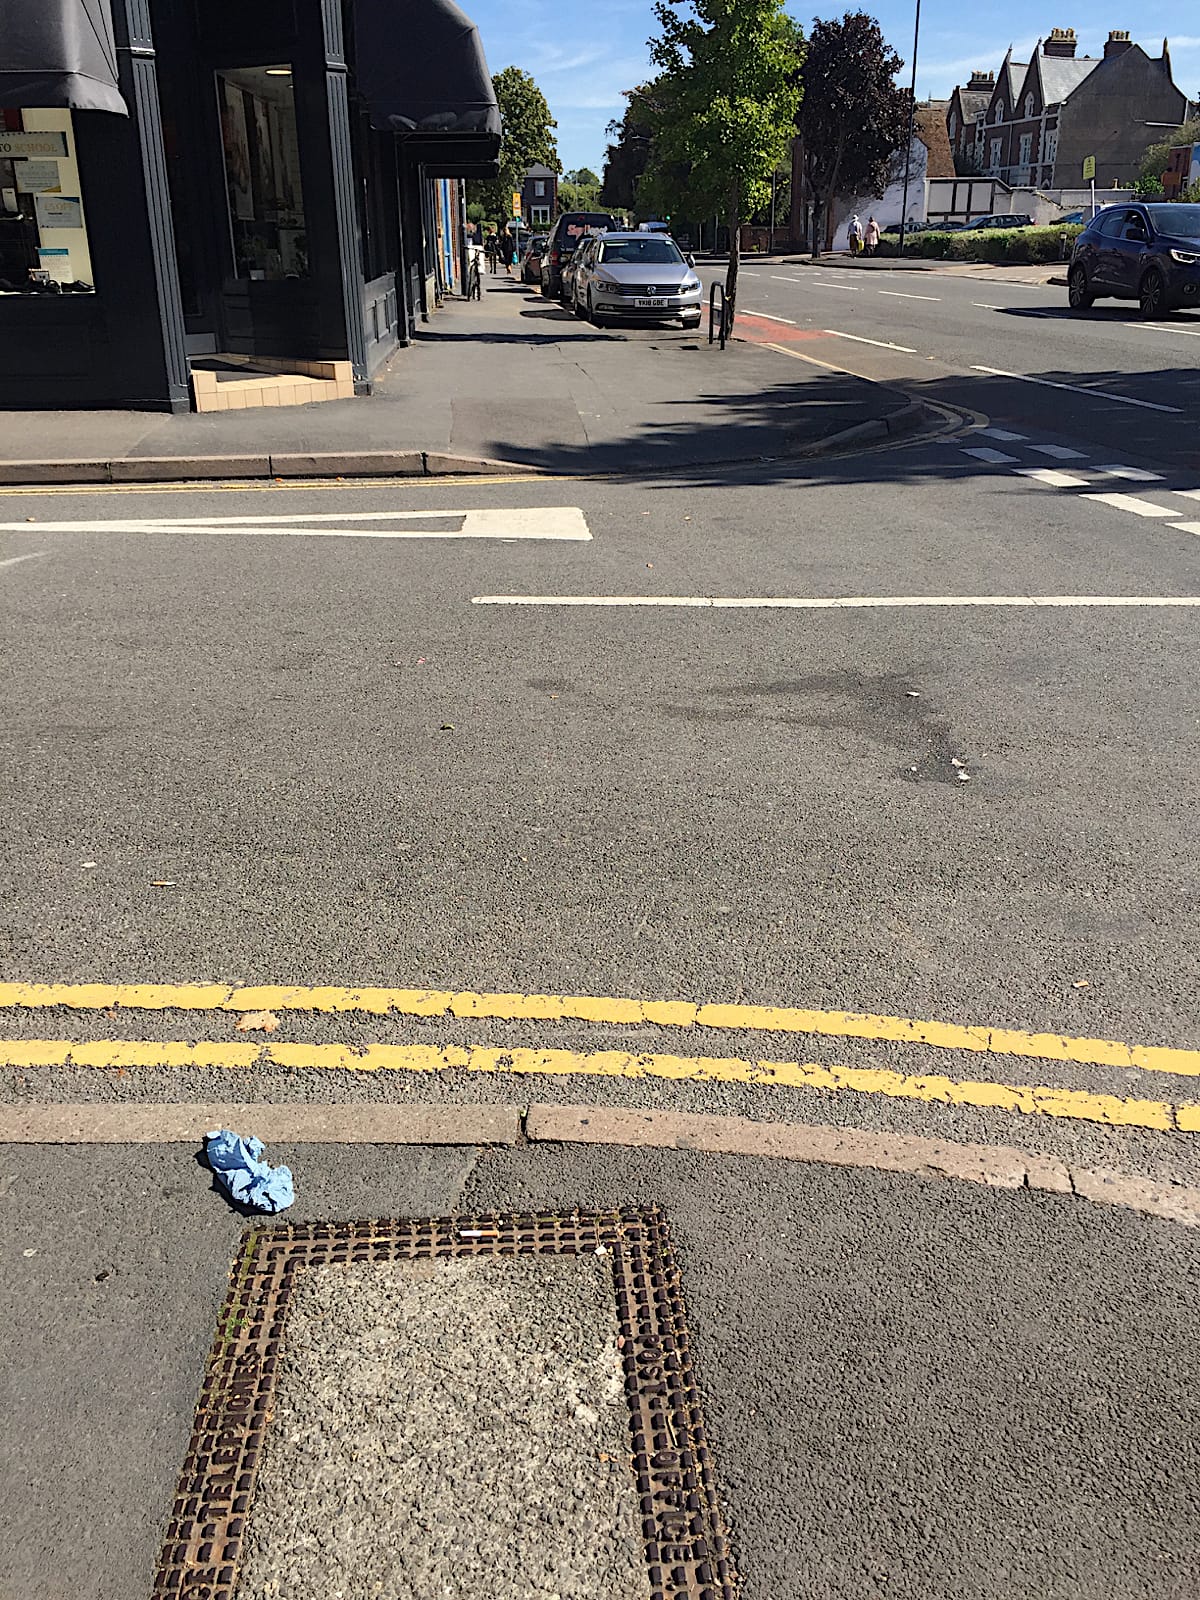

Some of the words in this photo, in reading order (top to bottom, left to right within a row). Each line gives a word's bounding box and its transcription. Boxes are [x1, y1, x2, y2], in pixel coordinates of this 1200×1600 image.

[15, 143, 58, 152] SCHOOL
[197, 1353, 261, 1524] TELEPHONES
[635, 1334, 667, 1396] POST
[652, 1451, 692, 1563] OFFICE
